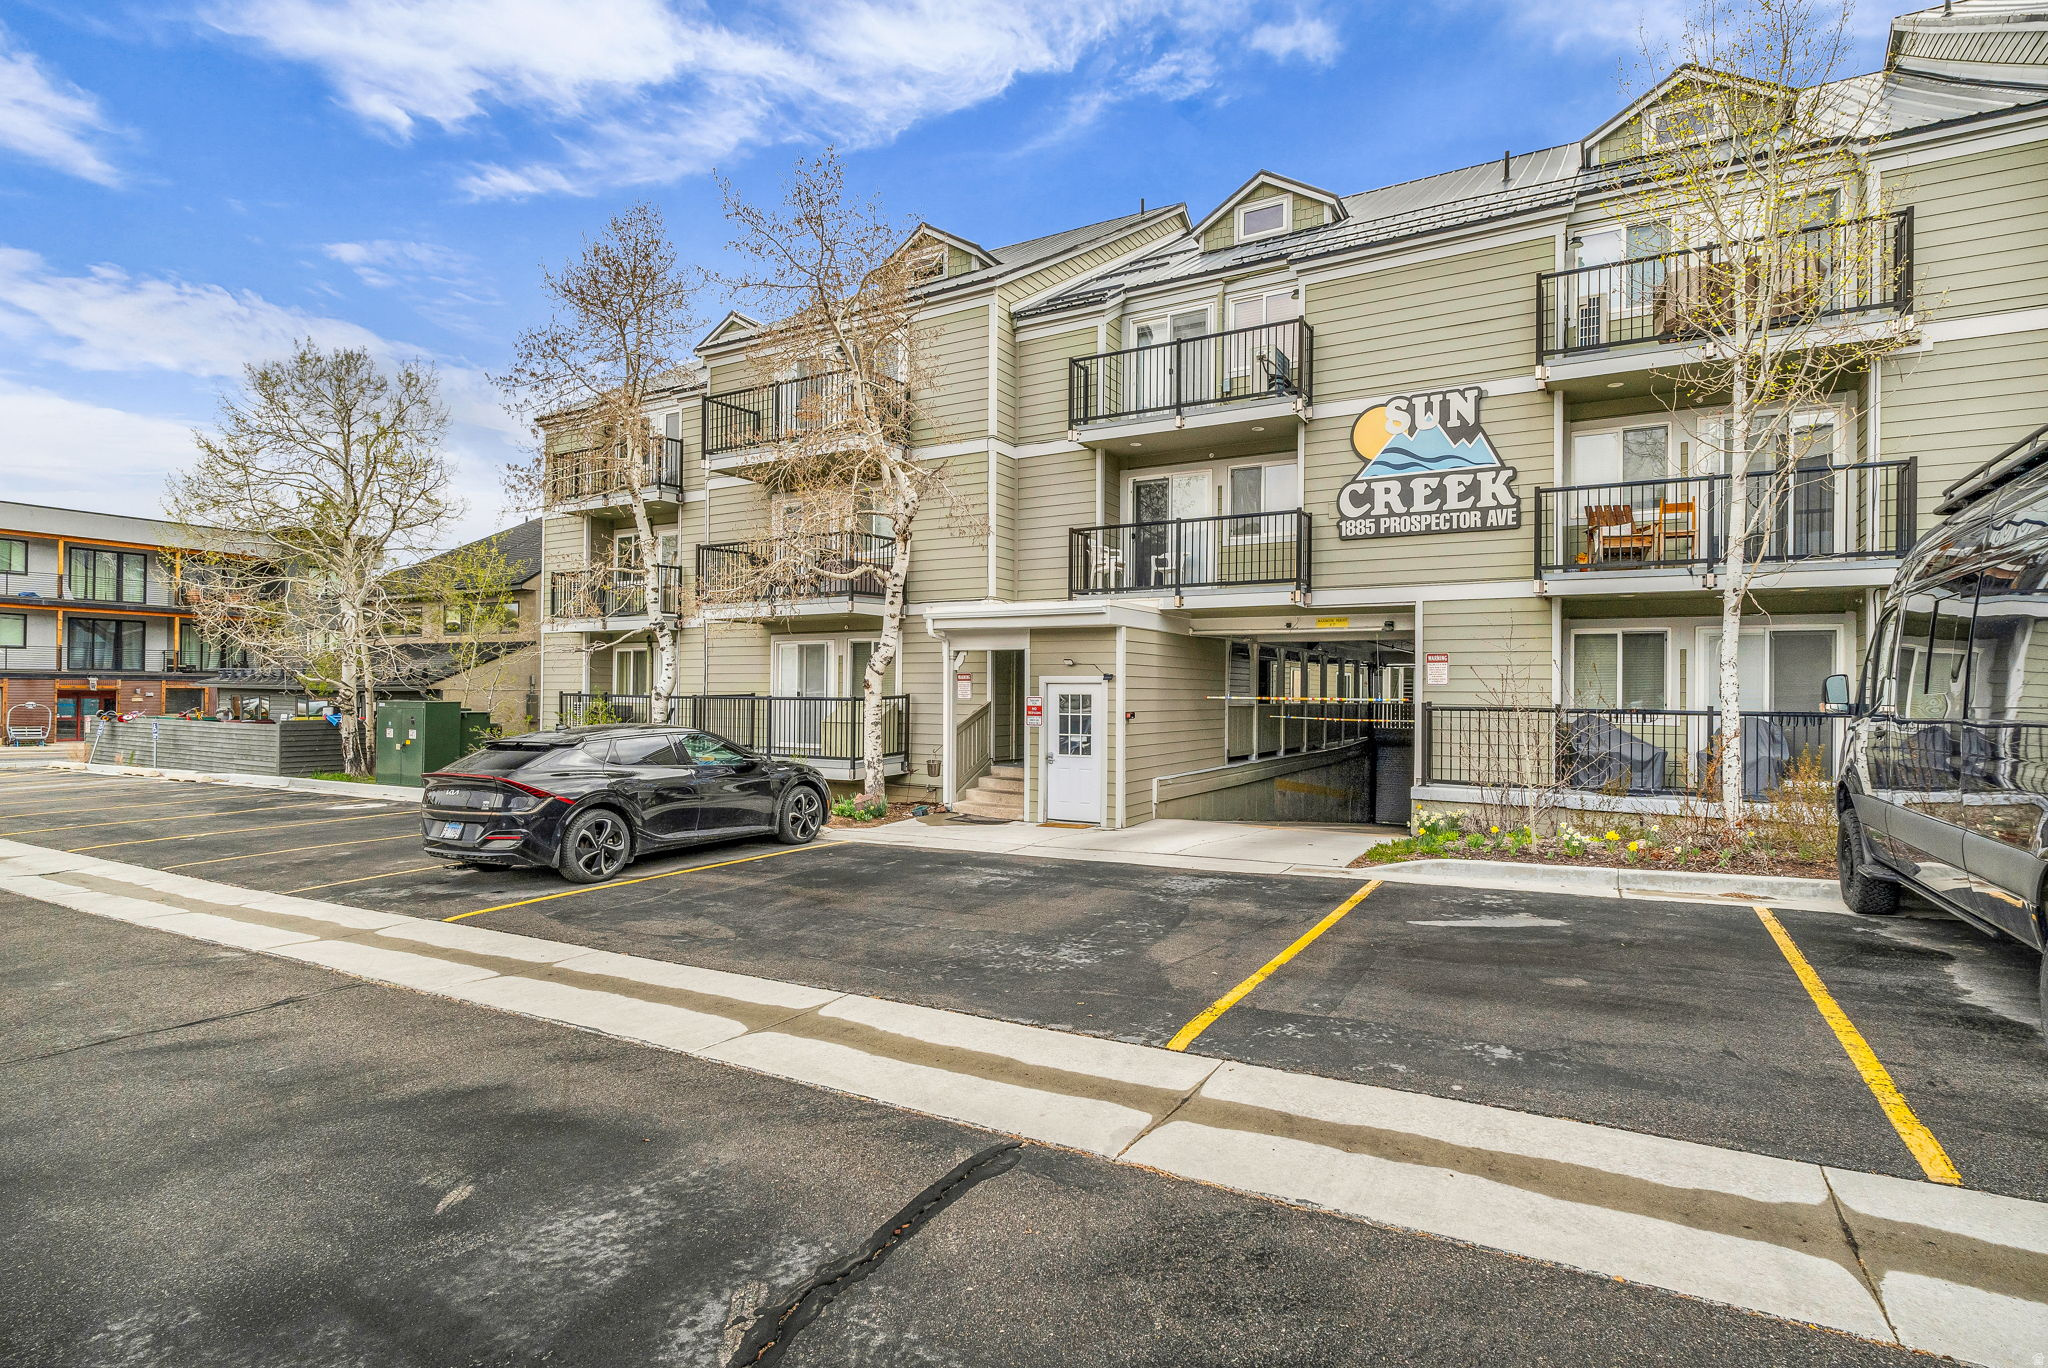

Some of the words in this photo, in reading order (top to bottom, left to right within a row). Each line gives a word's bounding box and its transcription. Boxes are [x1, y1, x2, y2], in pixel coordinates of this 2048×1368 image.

[1385, 389, 1479, 435] SUN
[1339, 469, 1517, 518] CREEK
[1339, 518, 1376, 537] 1885
[1380, 511, 1482, 534] PROSPECTOR
[1486, 508, 1517, 527] AVE
